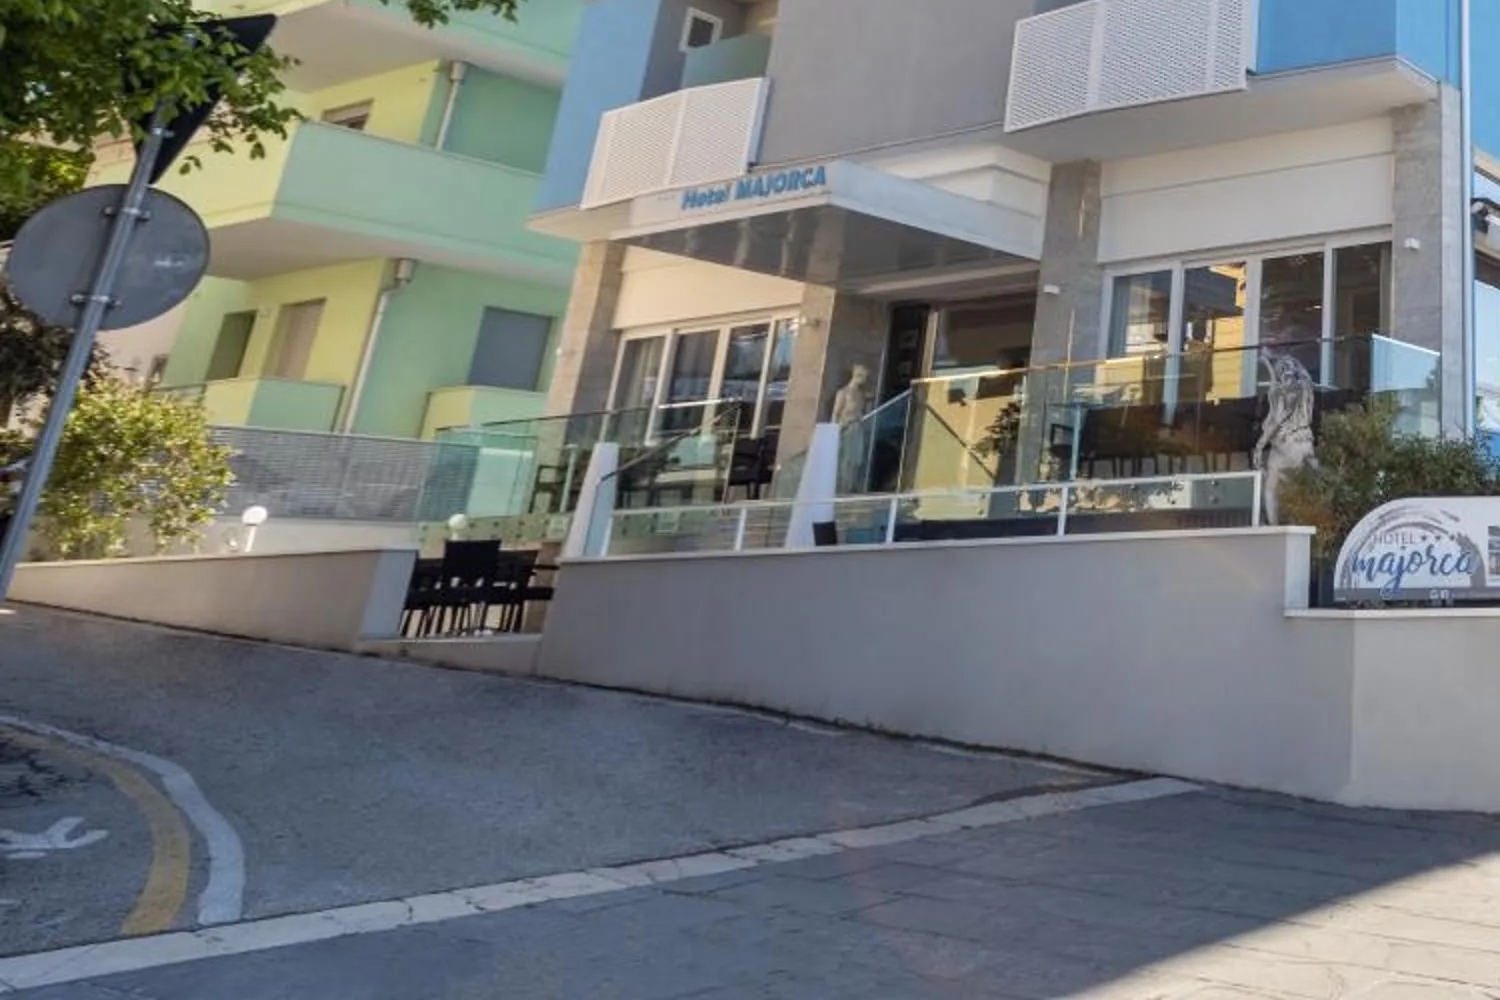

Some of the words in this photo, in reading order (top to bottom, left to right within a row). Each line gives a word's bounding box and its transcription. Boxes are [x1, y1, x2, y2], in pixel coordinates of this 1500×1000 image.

[681, 185, 731, 209] Hotel
[734, 166, 826, 199] MAJORCA
[1373, 531, 1416, 545] HOTEL
[1351, 544, 1474, 597] majorca
